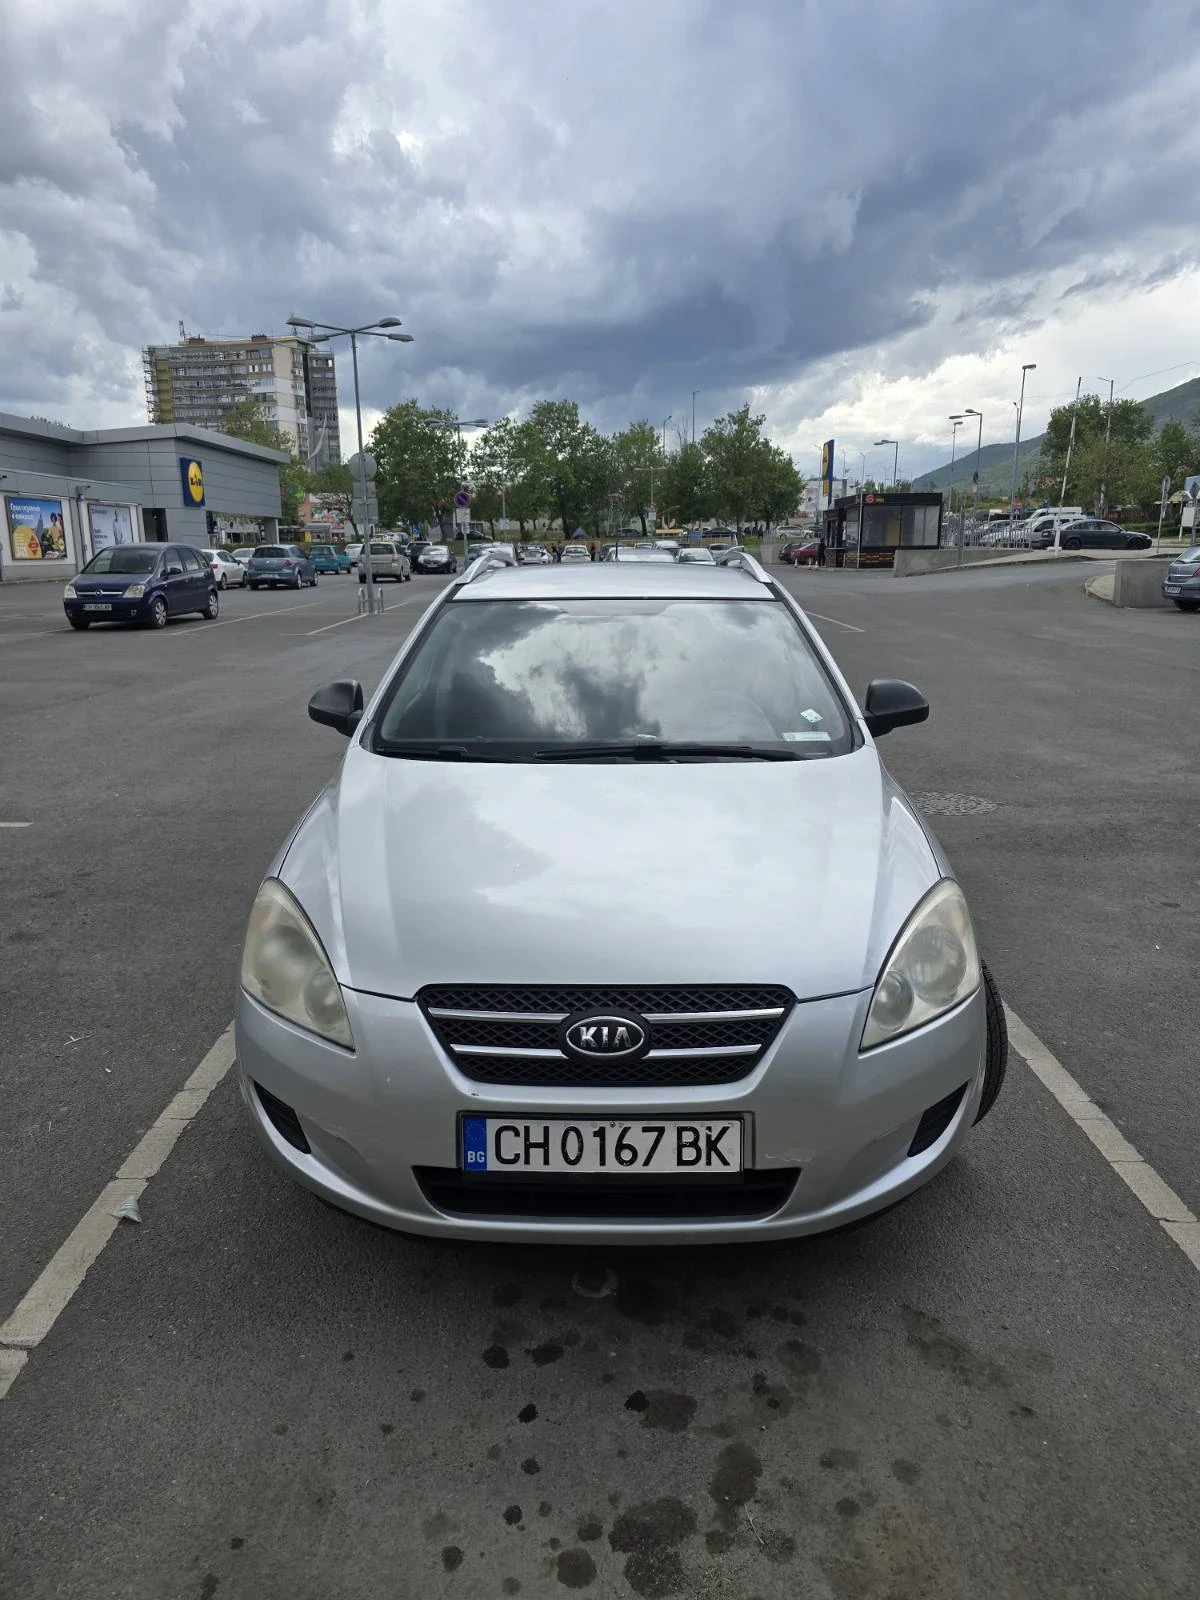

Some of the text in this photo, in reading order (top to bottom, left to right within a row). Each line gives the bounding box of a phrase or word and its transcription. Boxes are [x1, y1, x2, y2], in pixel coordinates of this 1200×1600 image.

[579, 1026, 632, 1047] KIA
[494, 1124, 731, 1167] CH 0167 BK
[467, 1151, 485, 1163] BG
